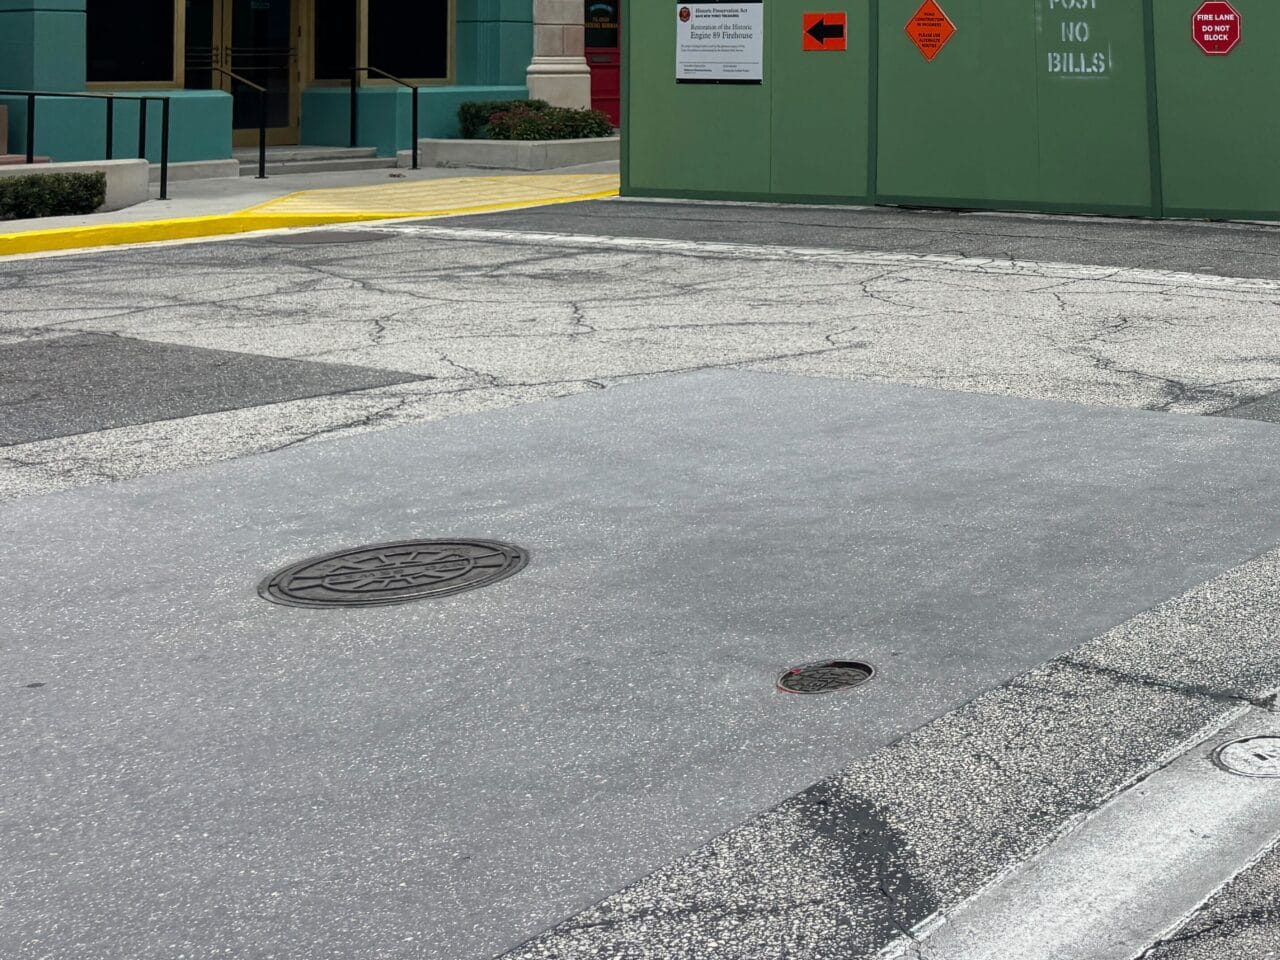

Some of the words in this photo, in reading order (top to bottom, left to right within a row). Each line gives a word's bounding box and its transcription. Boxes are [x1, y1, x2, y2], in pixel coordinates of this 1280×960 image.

[732, 23, 753, 31] Historic
[1061, 22, 1089, 42] NO
[690, 31, 712, 40] Engine
[712, 31, 721, 39] 89
[722, 31, 753, 40] Firehouse
[1047, 52, 1106, 73] BILLS
